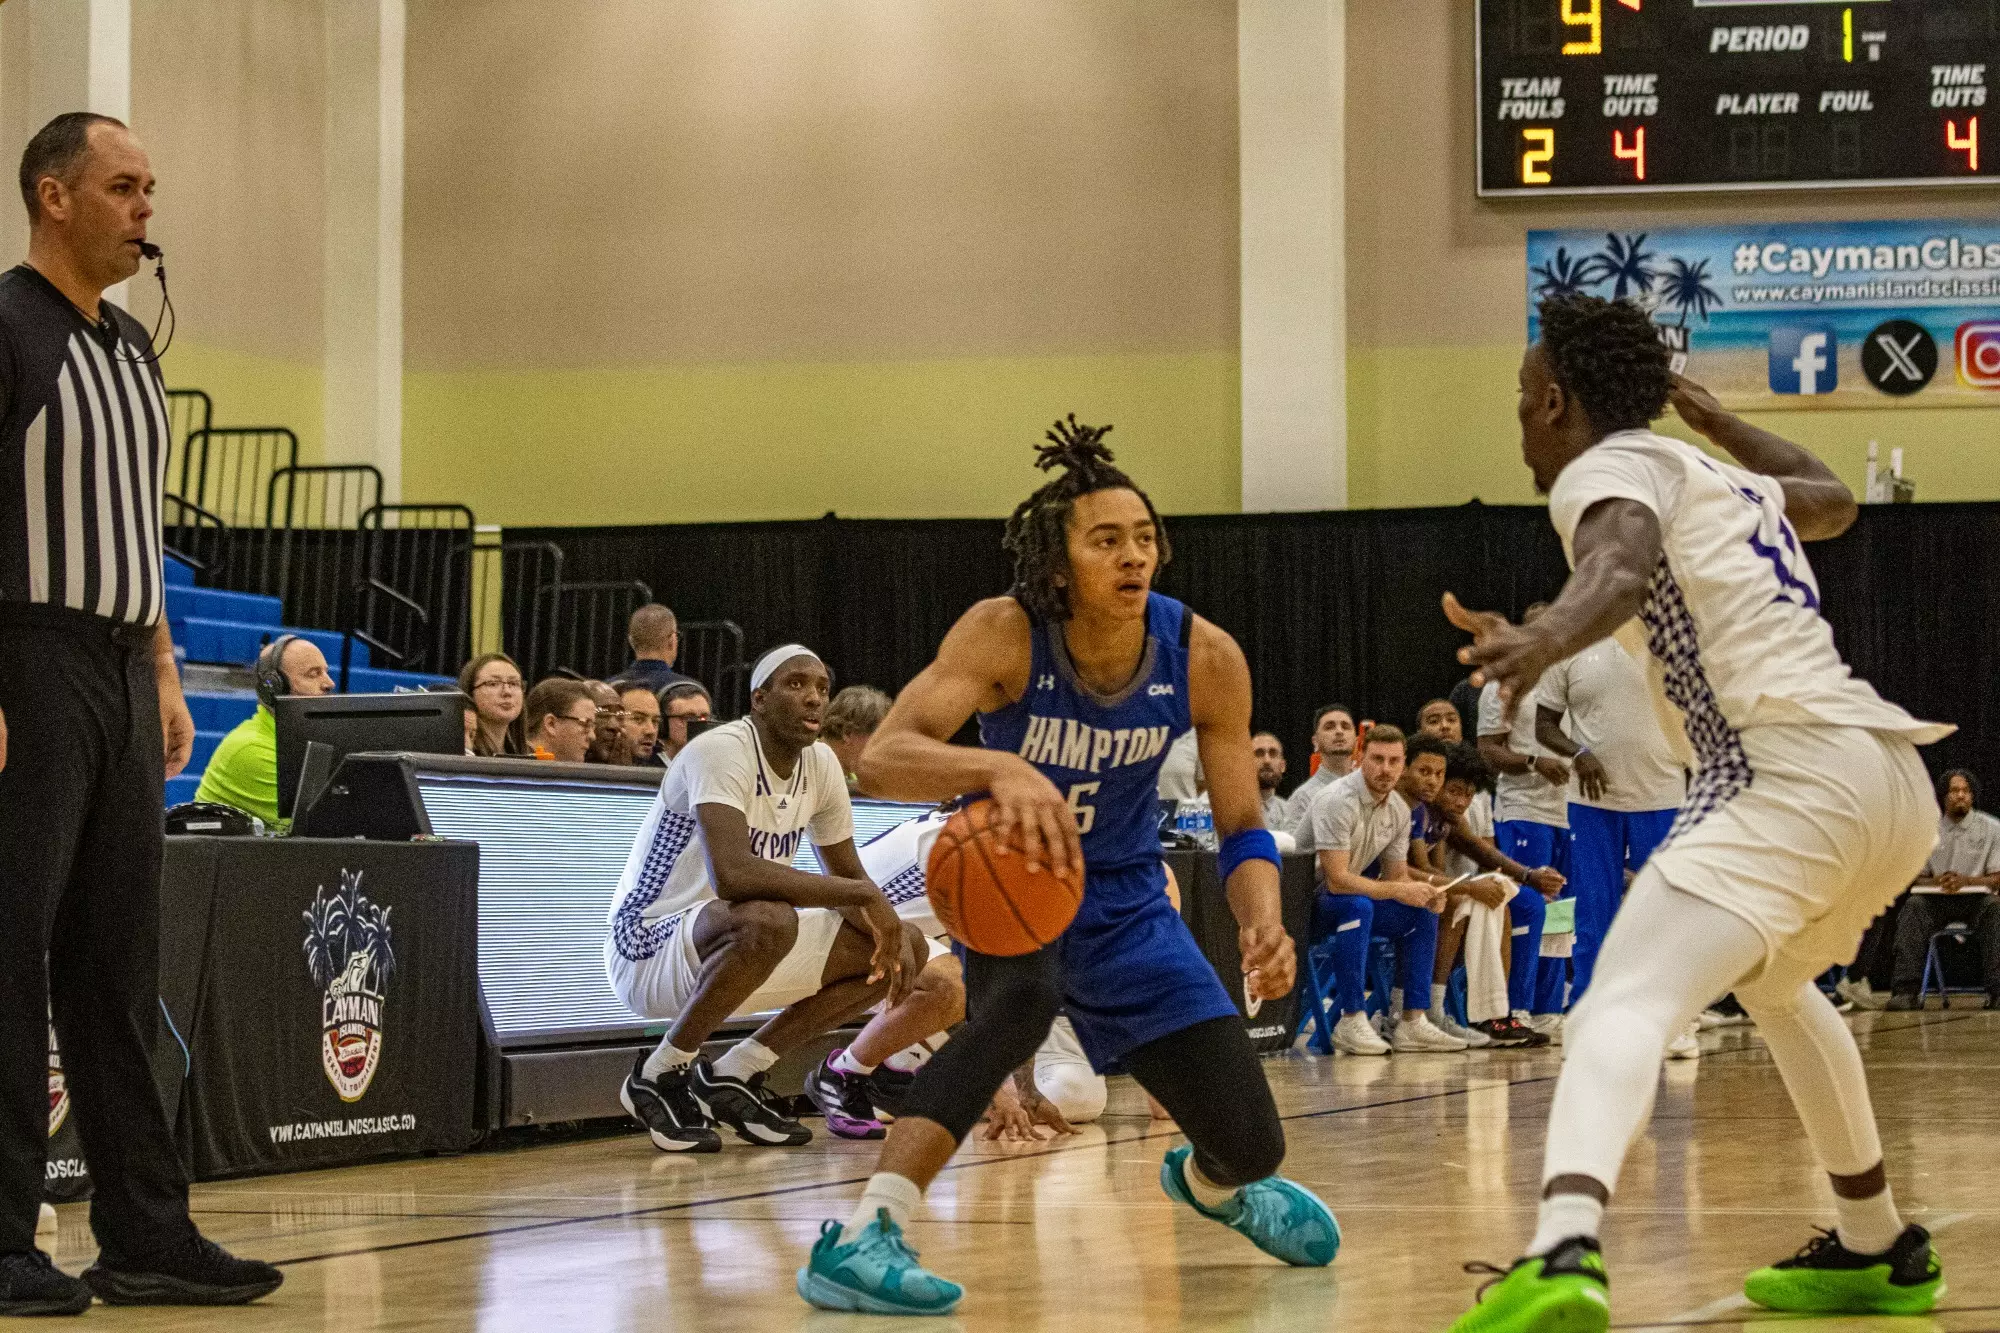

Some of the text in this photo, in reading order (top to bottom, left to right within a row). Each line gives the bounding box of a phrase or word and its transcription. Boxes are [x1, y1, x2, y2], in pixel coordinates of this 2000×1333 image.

[1709, 24, 1810, 53] PERIOD
[1843, 8, 1852, 62] 1
[1501, 76, 1562, 97] TEAM
[1603, 73, 1658, 95] TIME
[1930, 64, 1986, 86] TIME
[1498, 97, 1566, 120] FOULS
[1602, 95, 1659, 117] OUTS
[1715, 90, 1873, 115] PLAYER FOUL
[1930, 86, 1987, 108] OUTS
[1522, 128, 1554, 183] 2
[1614, 126, 1645, 180] 4
[1946, 116, 1978, 171] 4
[1019, 714, 1170, 773] HAMPTON
[323, 990, 379, 1029] CAYMAN
